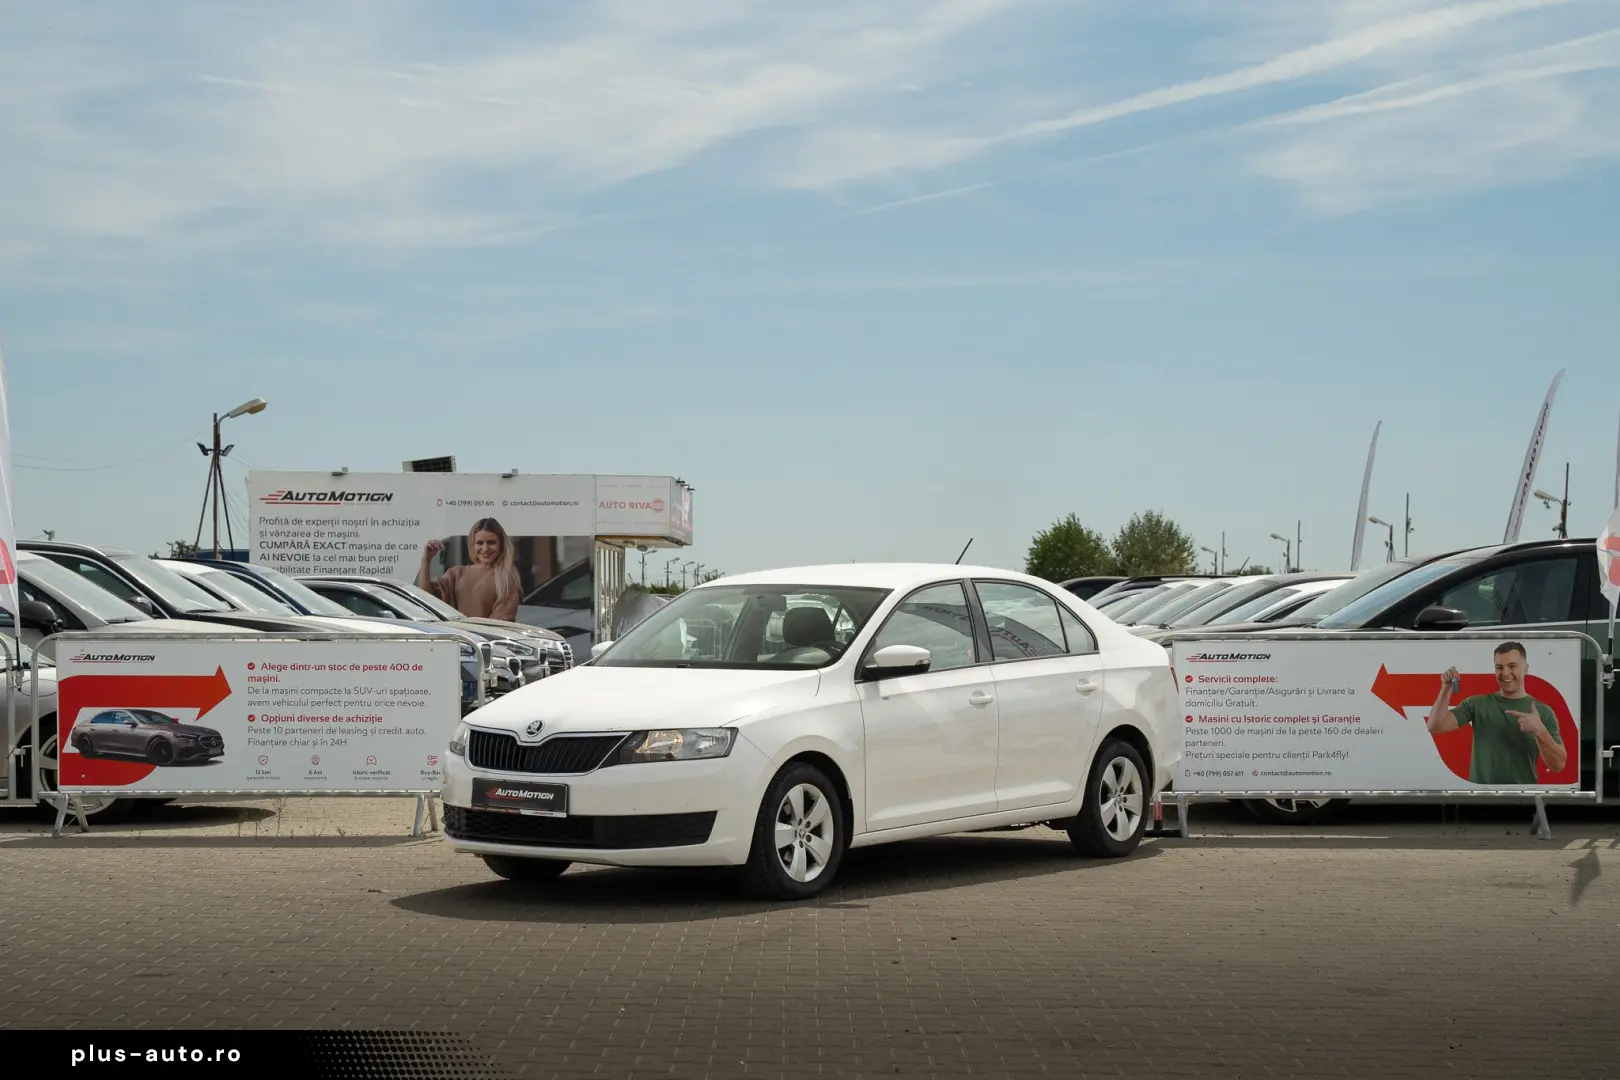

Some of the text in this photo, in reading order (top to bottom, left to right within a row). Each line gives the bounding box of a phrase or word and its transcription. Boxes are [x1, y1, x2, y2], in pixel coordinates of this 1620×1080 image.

[509, 498, 579, 507] contact@automotion.ro
[598, 501, 627, 510] AUTO
[628, 501, 652, 510] RIVA
[291, 516, 304, 526] de
[313, 529, 326, 538] de
[313, 541, 347, 550] EXACT
[384, 541, 397, 551] de
[398, 542, 419, 551] care
[259, 553, 270, 562] AI
[272, 553, 311, 562] NEVOIE
[312, 553, 322, 563] la
[323, 553, 337, 563] cel
[338, 554, 357, 563] mai
[358, 553, 377, 563] bun
[260, 662, 424, 674] Alege dintr-un stoc de peste 400 de
[1198, 674, 1279, 686] Servicii complete:
[247, 685, 261, 695] De
[261, 685, 270, 695] la
[299, 686, 343, 698] compacte
[344, 686, 352, 695] la
[353, 686, 388, 696] SUV-uri
[1316, 686, 1346, 696] Livrare
[1347, 686, 1356, 696] la
[271, 698, 309, 708] vehiculul
[310, 698, 342, 710] perfect
[343, 699, 372, 710] pentru
[373, 699, 396, 708] orice
[397, 699, 427, 708] nevoie.
[1185, 698, 1258, 708] domiciliu Gratuit.
[296, 714, 331, 723] diverse
[332, 714, 344, 723] de
[1231, 716, 1243, 724] cu
[1243, 714, 1272, 724] Istoric
[1273, 714, 1311, 726] complet
[247, 726, 272, 735] Peste
[273, 726, 284, 735] 10
[284, 726, 325, 738] parteneri
[325, 726, 337, 736] de
[338, 726, 368, 738] leasing
[378, 726, 404, 736] credit
[405, 727, 427, 736] auto.
[1185, 726, 1209, 736] Peste
[1210, 726, 1232, 736] 1000
[1234, 726, 1246, 736] de
[1276, 726, 1287, 736] de
[1288, 726, 1297, 736] la
[1298, 727, 1323, 738] peste
[1324, 726, 1339, 736] 160
[1340, 726, 1353, 736] de
[1354, 726, 1384, 736] dealeri
[289, 737, 310, 747] chiar
[329, 738, 348, 747] 24H
[1185, 739, 1227, 750] parteneri.
[1215, 750, 1251, 762] speciale
[1251, 751, 1281, 762] pentru
[1312, 750, 1349, 762] Park4fly!
[369, 768, 391, 776] verificat
[1205, 769, 1222, 778] (799)
[1222, 769, 1234, 777] 057
[1234, 769, 1244, 777] 611
[1260, 769, 1332, 778] contact@automotion.ro
[494, 787, 555, 801] AUTOMOTION
